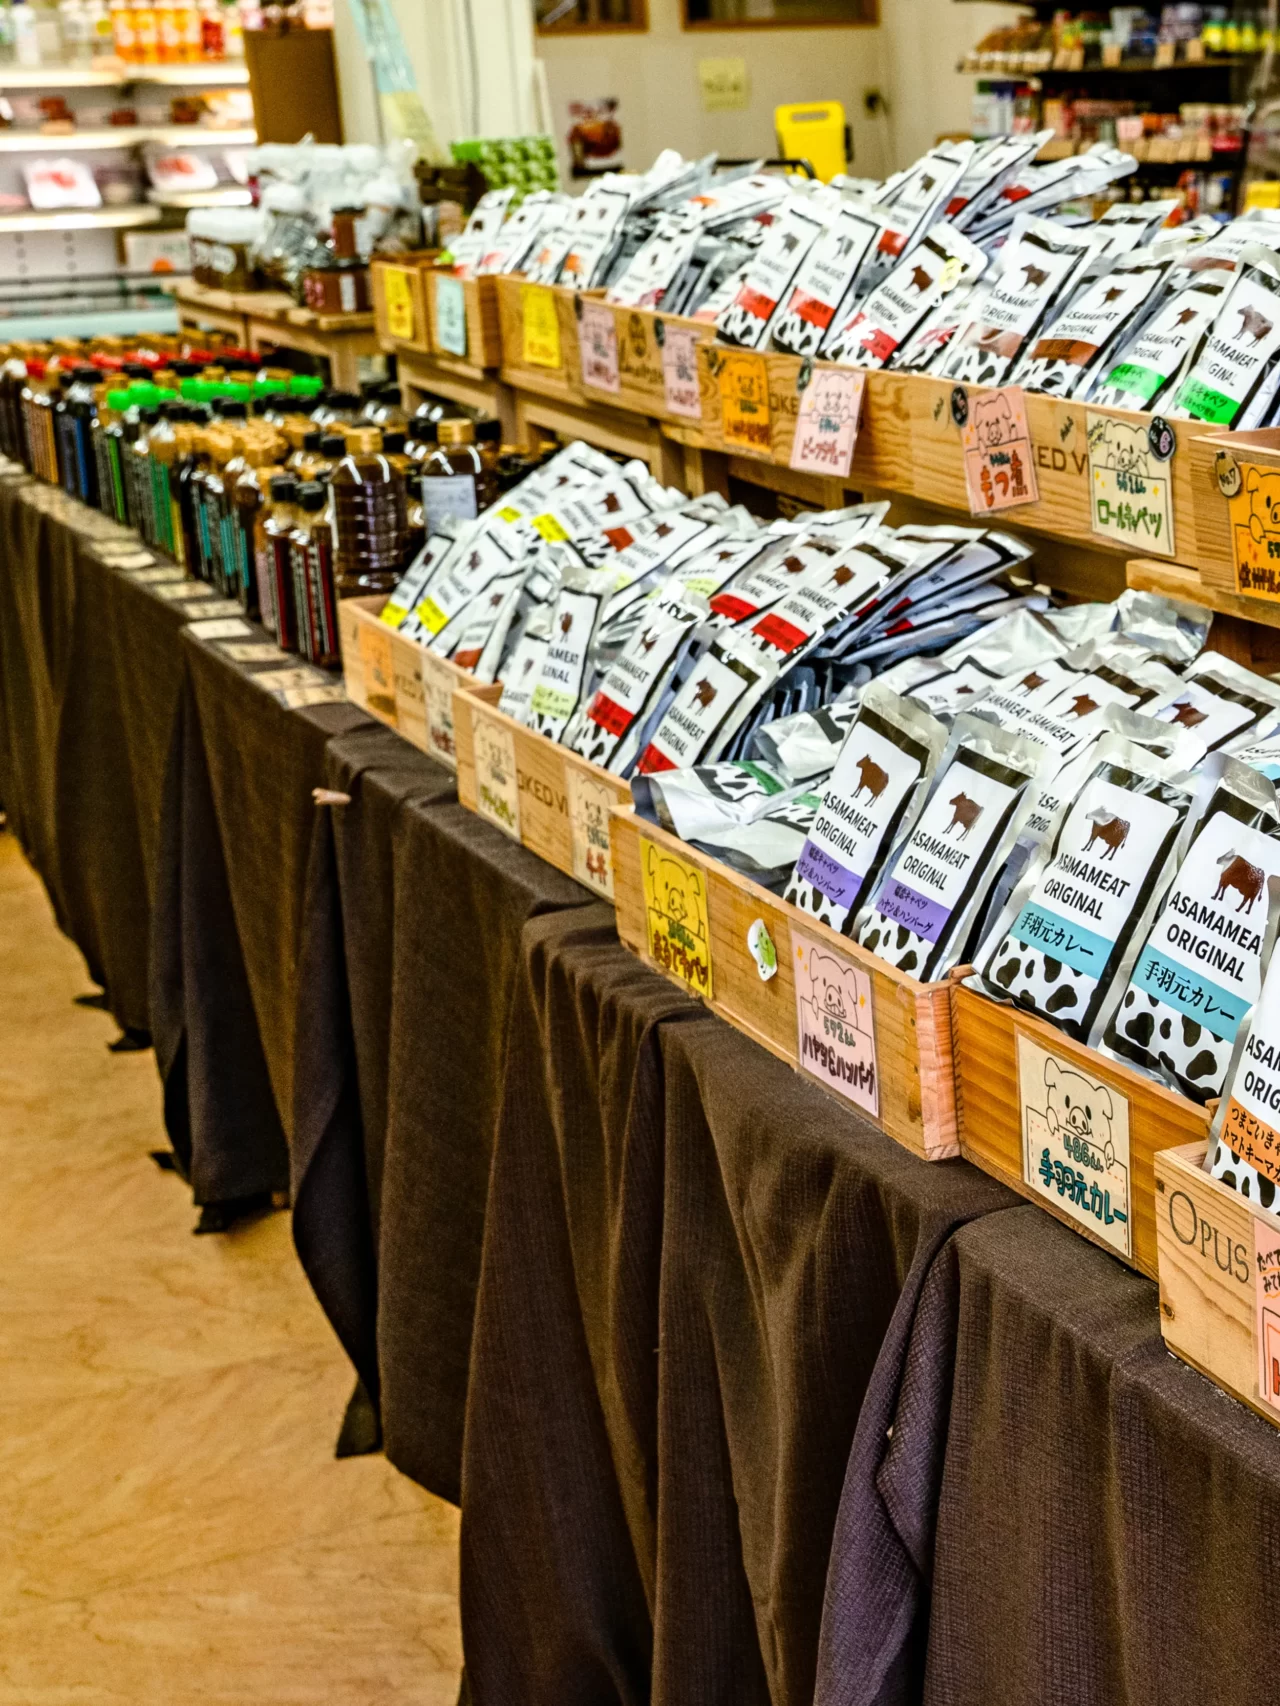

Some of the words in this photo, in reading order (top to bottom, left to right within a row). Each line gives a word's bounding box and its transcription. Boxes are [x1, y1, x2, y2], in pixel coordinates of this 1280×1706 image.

[815, 817, 858, 858] ORIGINAL
[823, 790, 879, 839] ASAMAMEAT
[903, 855, 949, 892] ORIGINAL
[911, 830, 971, 871] ASAMAMEAT
[1054, 851, 1131, 899] ASAMAMEAT
[1042, 878, 1104, 922] ORIGINAL
[1019, 910, 1095, 958] 手羽元カレー
[1166, 923, 1245, 983] ORIGINAL
[1144, 959, 1236, 1022] 手羽元カレー
[1038, 1147, 1128, 1226] 手羽元カレー
